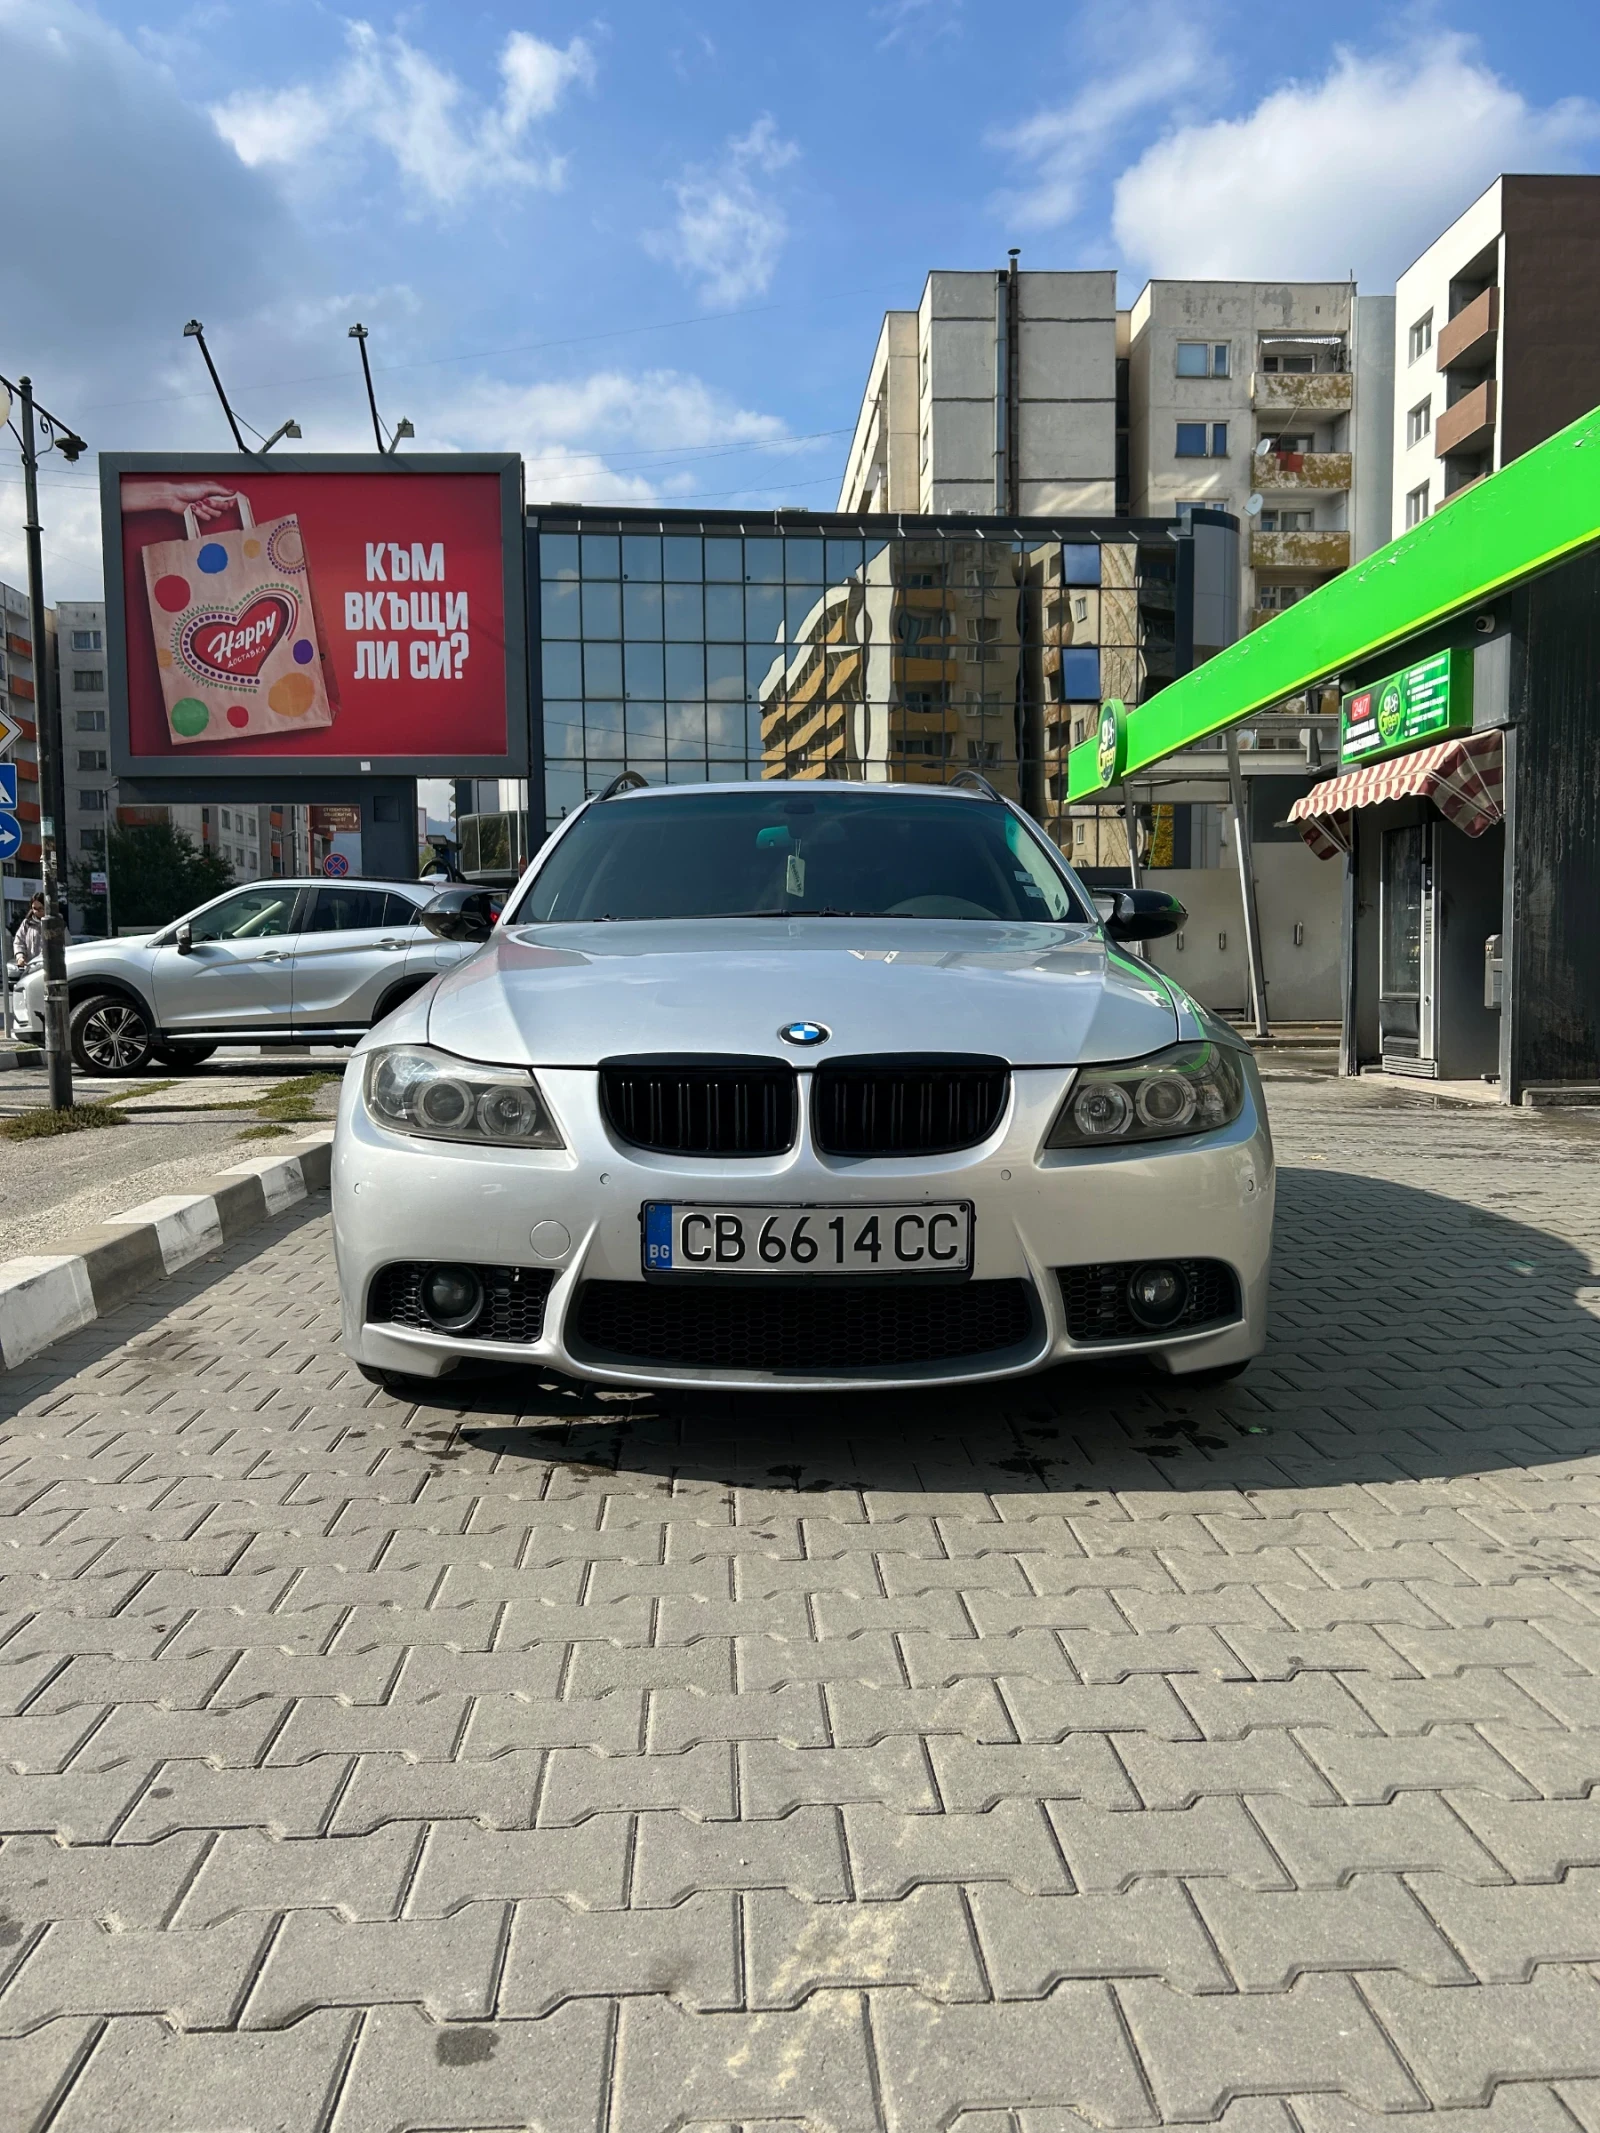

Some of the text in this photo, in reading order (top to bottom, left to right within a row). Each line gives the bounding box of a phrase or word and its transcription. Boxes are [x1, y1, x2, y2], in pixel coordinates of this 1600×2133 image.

[366, 542, 445, 582] КЪМ
[207, 610, 277, 664] Happy
[344, 591, 469, 638] ВКЪЩИ
[227, 645, 267, 669] ДОСТАВКА
[353, 632, 470, 680] ЛИ СИ?
[649, 1244, 670, 1259] BG
[681, 1213, 958, 1264] CB 6614 CC
